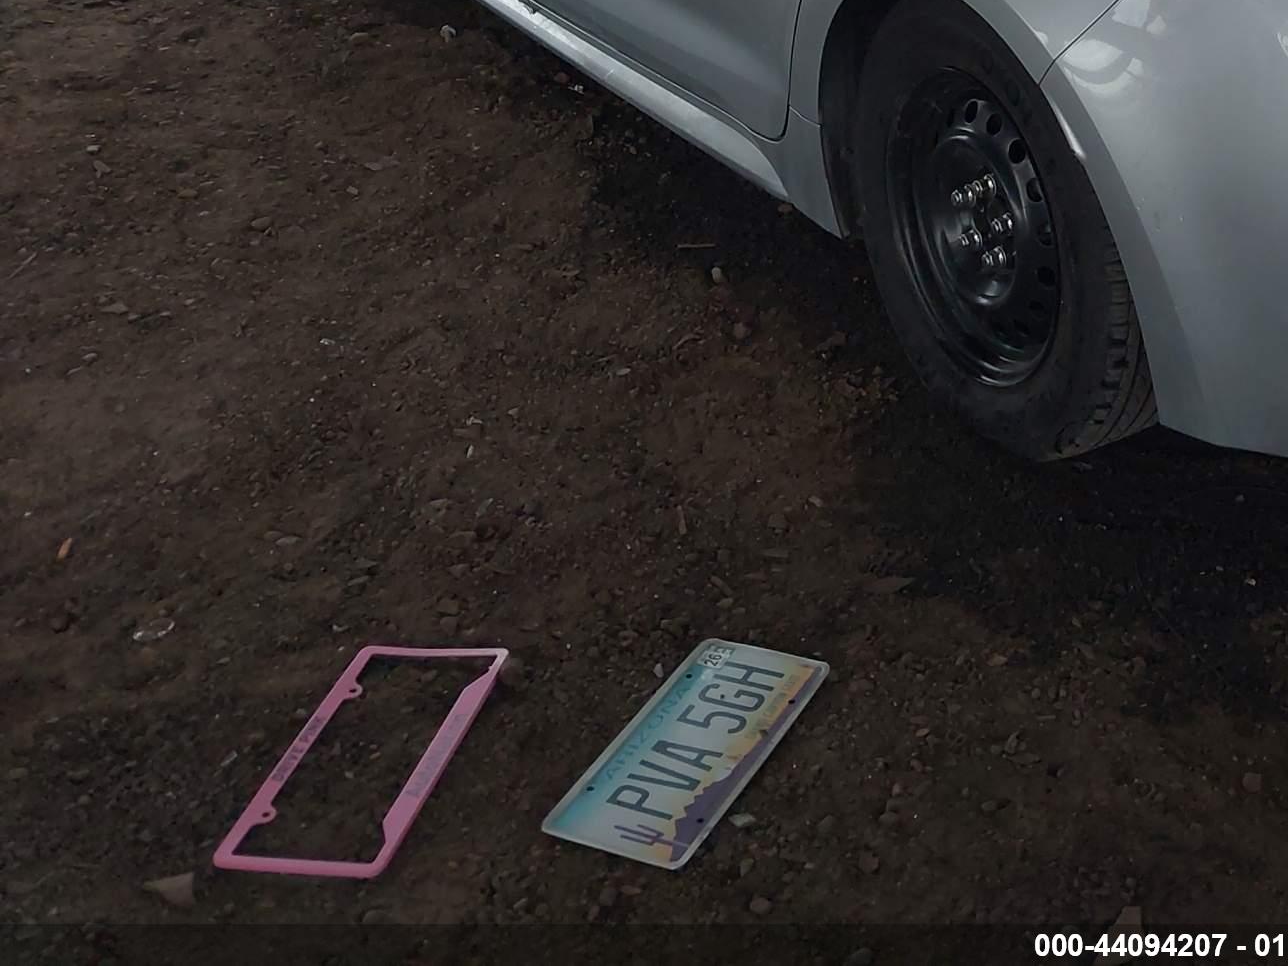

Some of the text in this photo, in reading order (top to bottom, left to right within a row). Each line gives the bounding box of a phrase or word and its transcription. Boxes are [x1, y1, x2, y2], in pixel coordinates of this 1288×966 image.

[704, 653, 723, 667] 26
[606, 686, 691, 780] ARIZONA
[606, 740, 723, 821] PVA
[677, 660, 785, 734] 5GH
